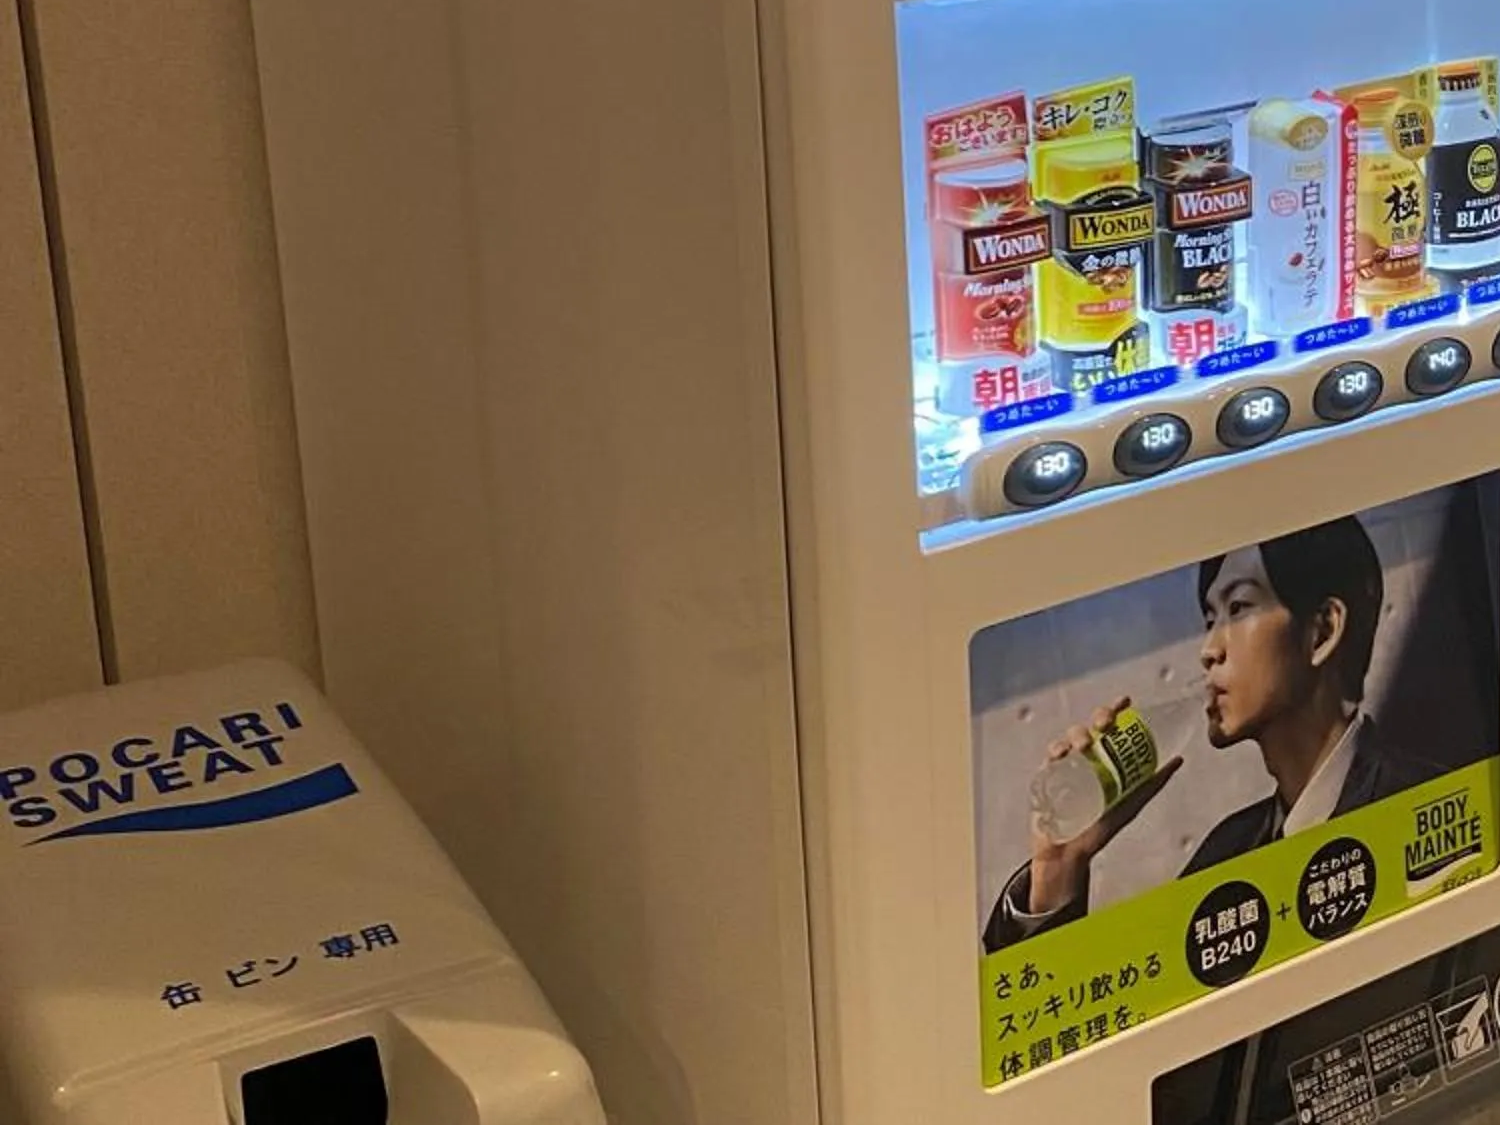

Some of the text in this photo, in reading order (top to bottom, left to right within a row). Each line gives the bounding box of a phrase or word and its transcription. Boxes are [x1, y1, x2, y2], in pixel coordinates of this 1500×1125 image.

[1177, 186, 1247, 219] WONDA
[1383, 179, 1421, 224] 極
[973, 233, 1046, 265] WONDA
[1078, 215, 1150, 240] WONDA
[1034, 452, 1070, 477] 130
[1142, 423, 1175, 448] 130
[1243, 396, 1274, 420] 130
[1338, 371, 1367, 394] 130
[1428, 346, 1457, 370] 140
[0, 702, 303, 801] POCARI
[1124, 722, 1153, 766] BODY
[9, 735, 285, 830] SWEAT
[1415, 794, 1469, 837] BODY
[1308, 847, 1363, 878] こだわりの
[1306, 863, 1368, 906] 電解質
[1194, 898, 1260, 945] 乳酸菌
[1307, 891, 1369, 929] バランス
[160, 922, 400, 1010] 缶 ビン 専用
[1200, 930, 1257, 972] B240
[993, 961, 1055, 1001] さあ、
[997, 952, 1162, 1042] スッキリ飲める
[999, 1004, 1147, 1082] 体調管理を。
